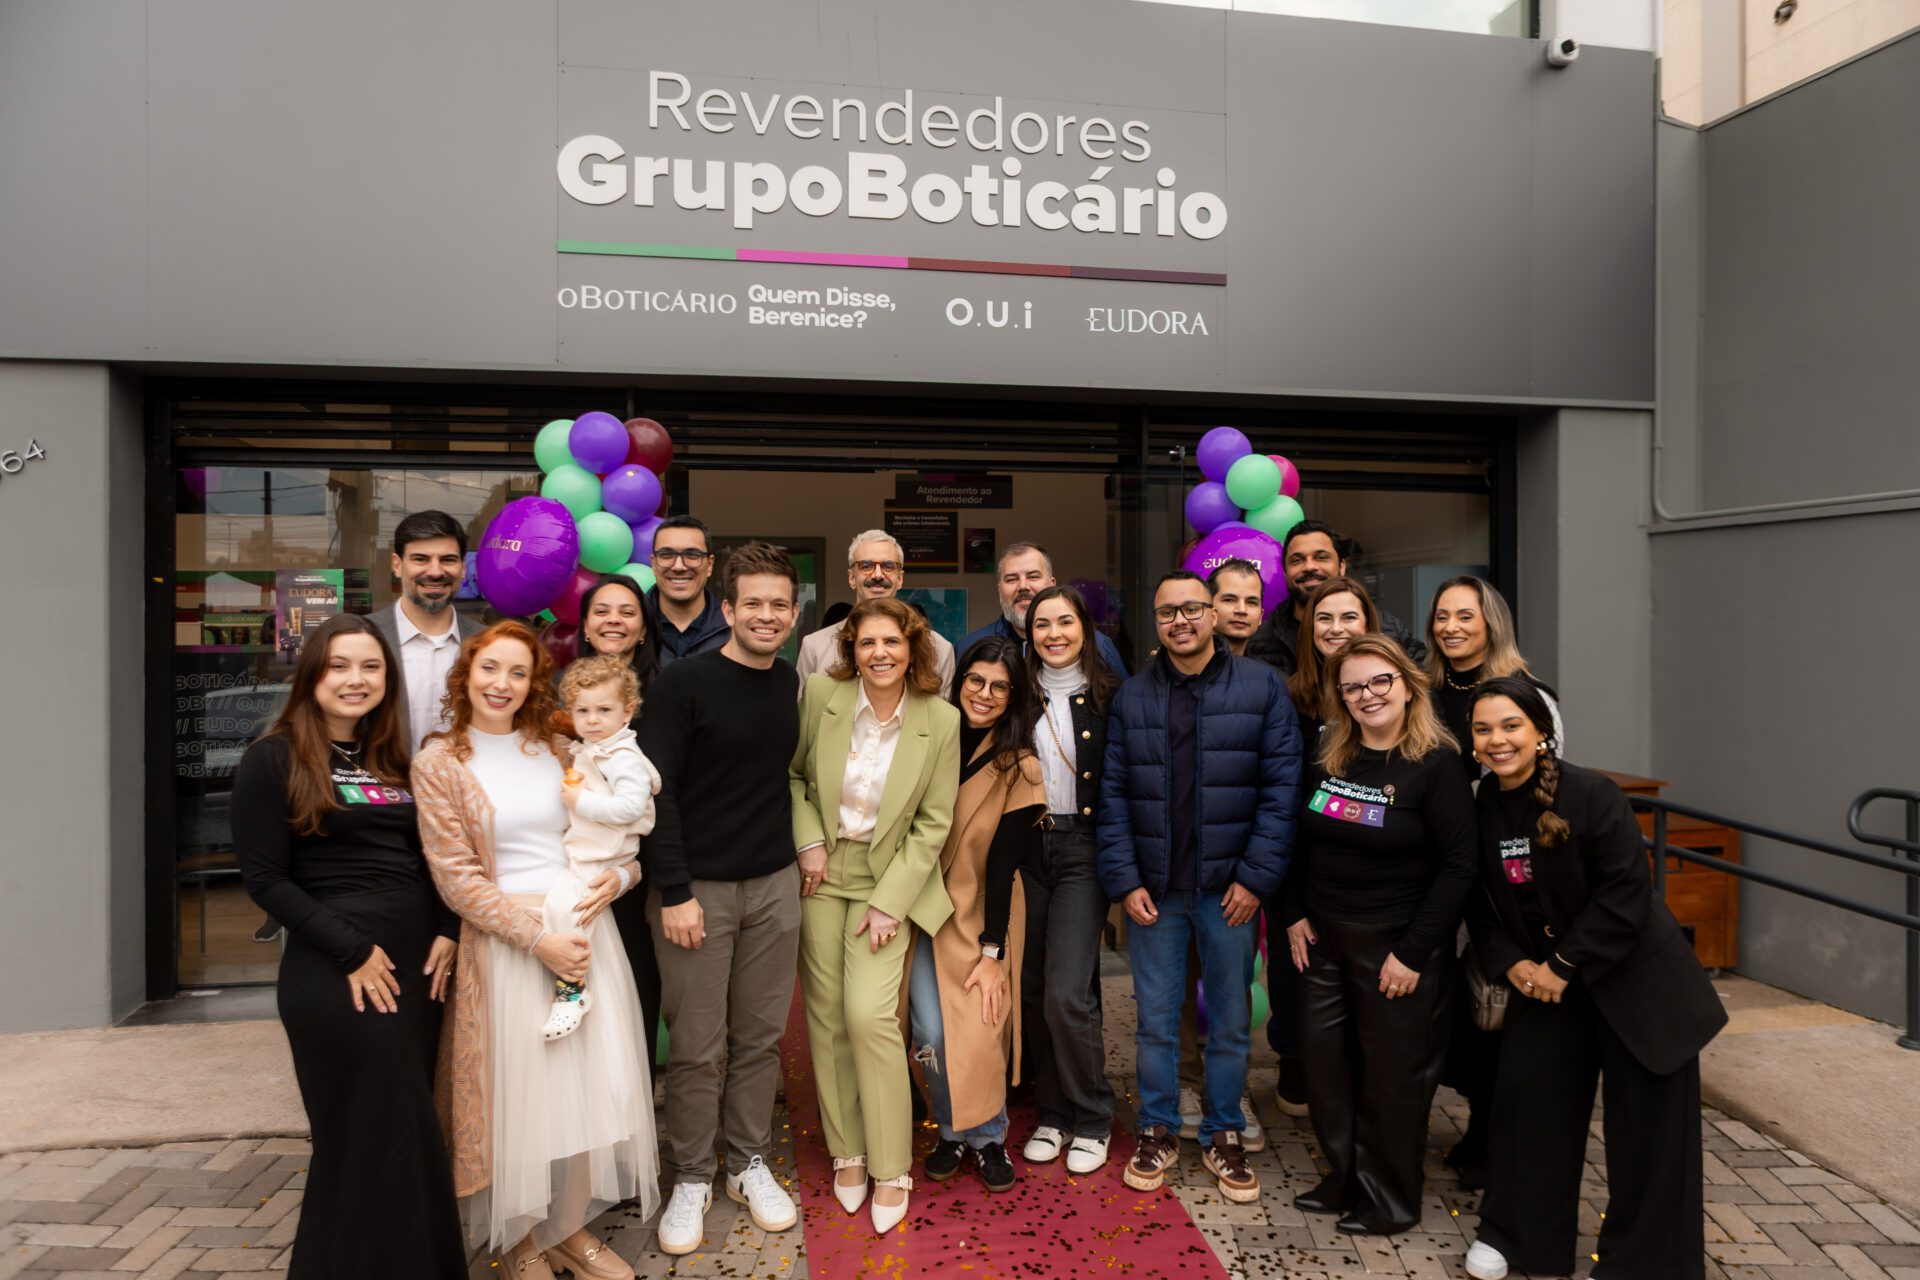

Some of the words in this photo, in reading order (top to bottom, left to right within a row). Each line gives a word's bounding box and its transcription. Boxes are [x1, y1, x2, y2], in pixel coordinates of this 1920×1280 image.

[649, 70, 1151, 162] Revendedores
[557, 135, 1228, 240] GrupoBoticário
[748, 284, 821, 306] Quem
[826, 287, 897, 312] Disse,
[749, 306, 868, 329] Berenice?
[945, 297, 1032, 329] O.U.i
[1085, 307, 1209, 335] EUDORA
[0, 439, 46, 474] 64
[917, 486, 978, 496] Atendimento
[980, 488, 992, 496] ao
[926, 495, 983, 504] Revendedor
[288, 588, 333, 597] EUDORA
[1320, 780, 1388, 803] GrupoBoticário
[1329, 776, 1382, 795] Revendedores
